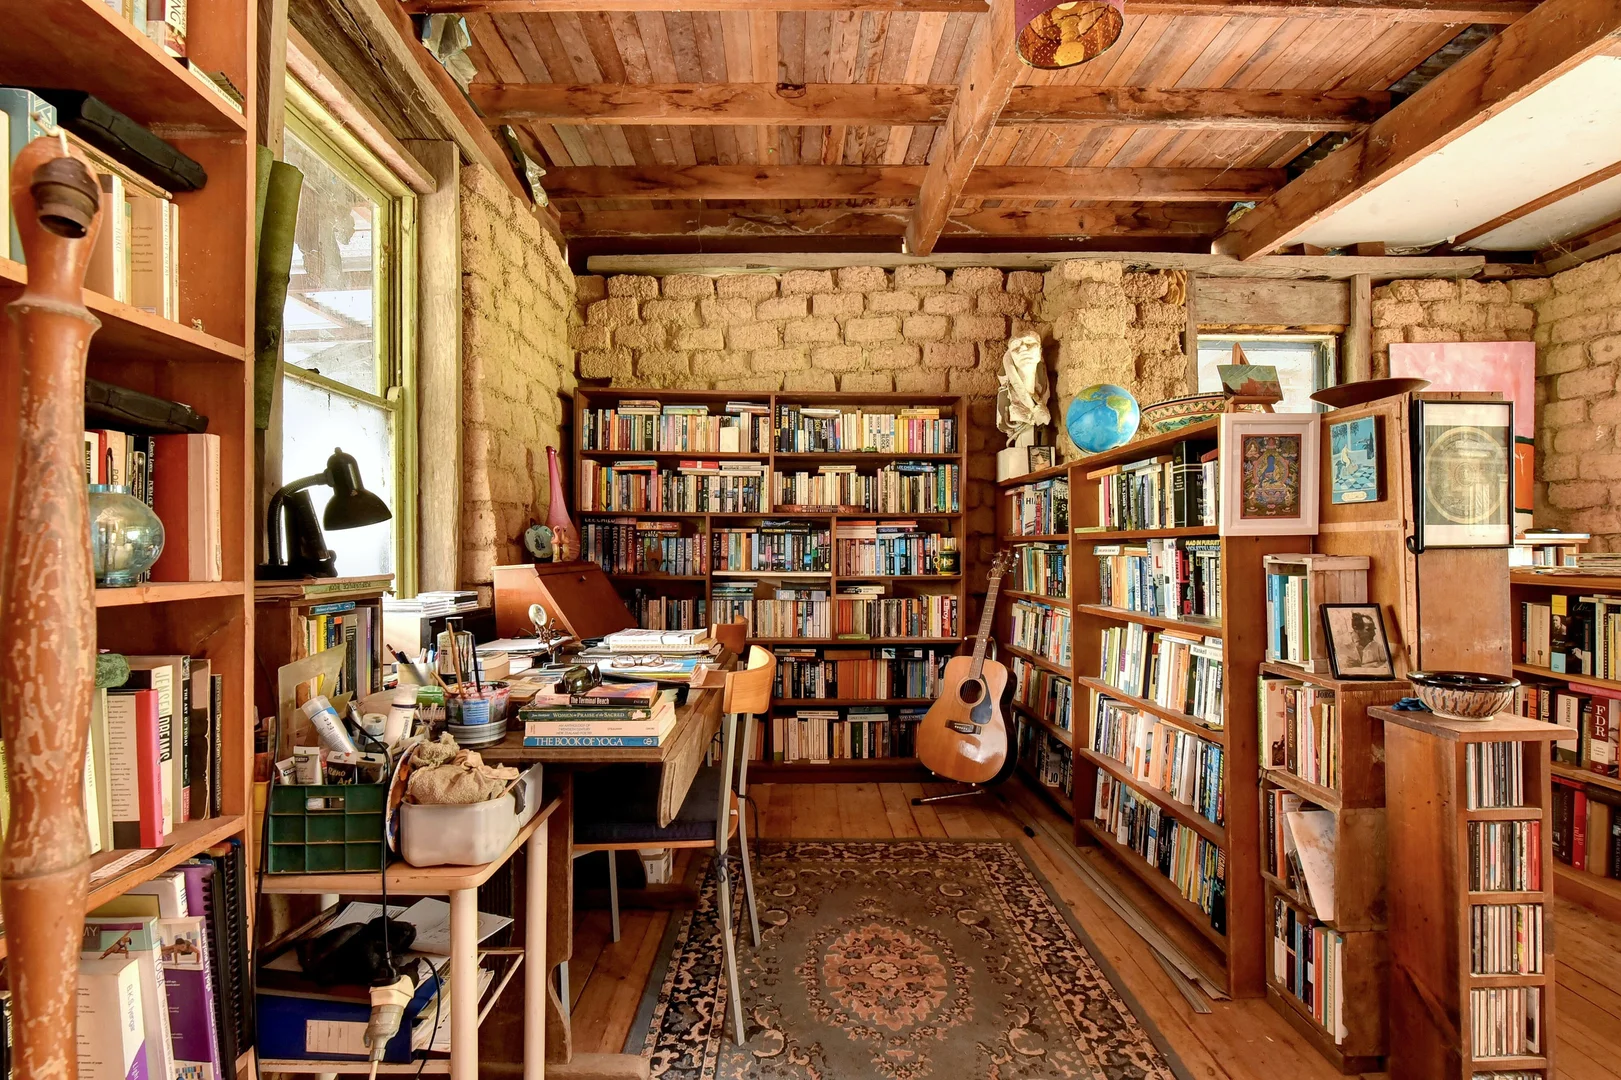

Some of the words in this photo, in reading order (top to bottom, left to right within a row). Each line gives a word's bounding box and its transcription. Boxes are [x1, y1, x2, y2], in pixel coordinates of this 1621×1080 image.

[156, 672, 170, 715] JENSEN
[184, 717, 188, 725] OF
[158, 717, 171, 760] DREAMS
[535, 738, 554, 746] THE
[555, 738, 581, 746] BOOK
[583, 737, 593, 746] OF
[593, 737, 624, 746] YOGA
[180, 888, 189, 905] THE
[201, 928, 210, 961] everyone
[155, 956, 164, 988] YOGA
